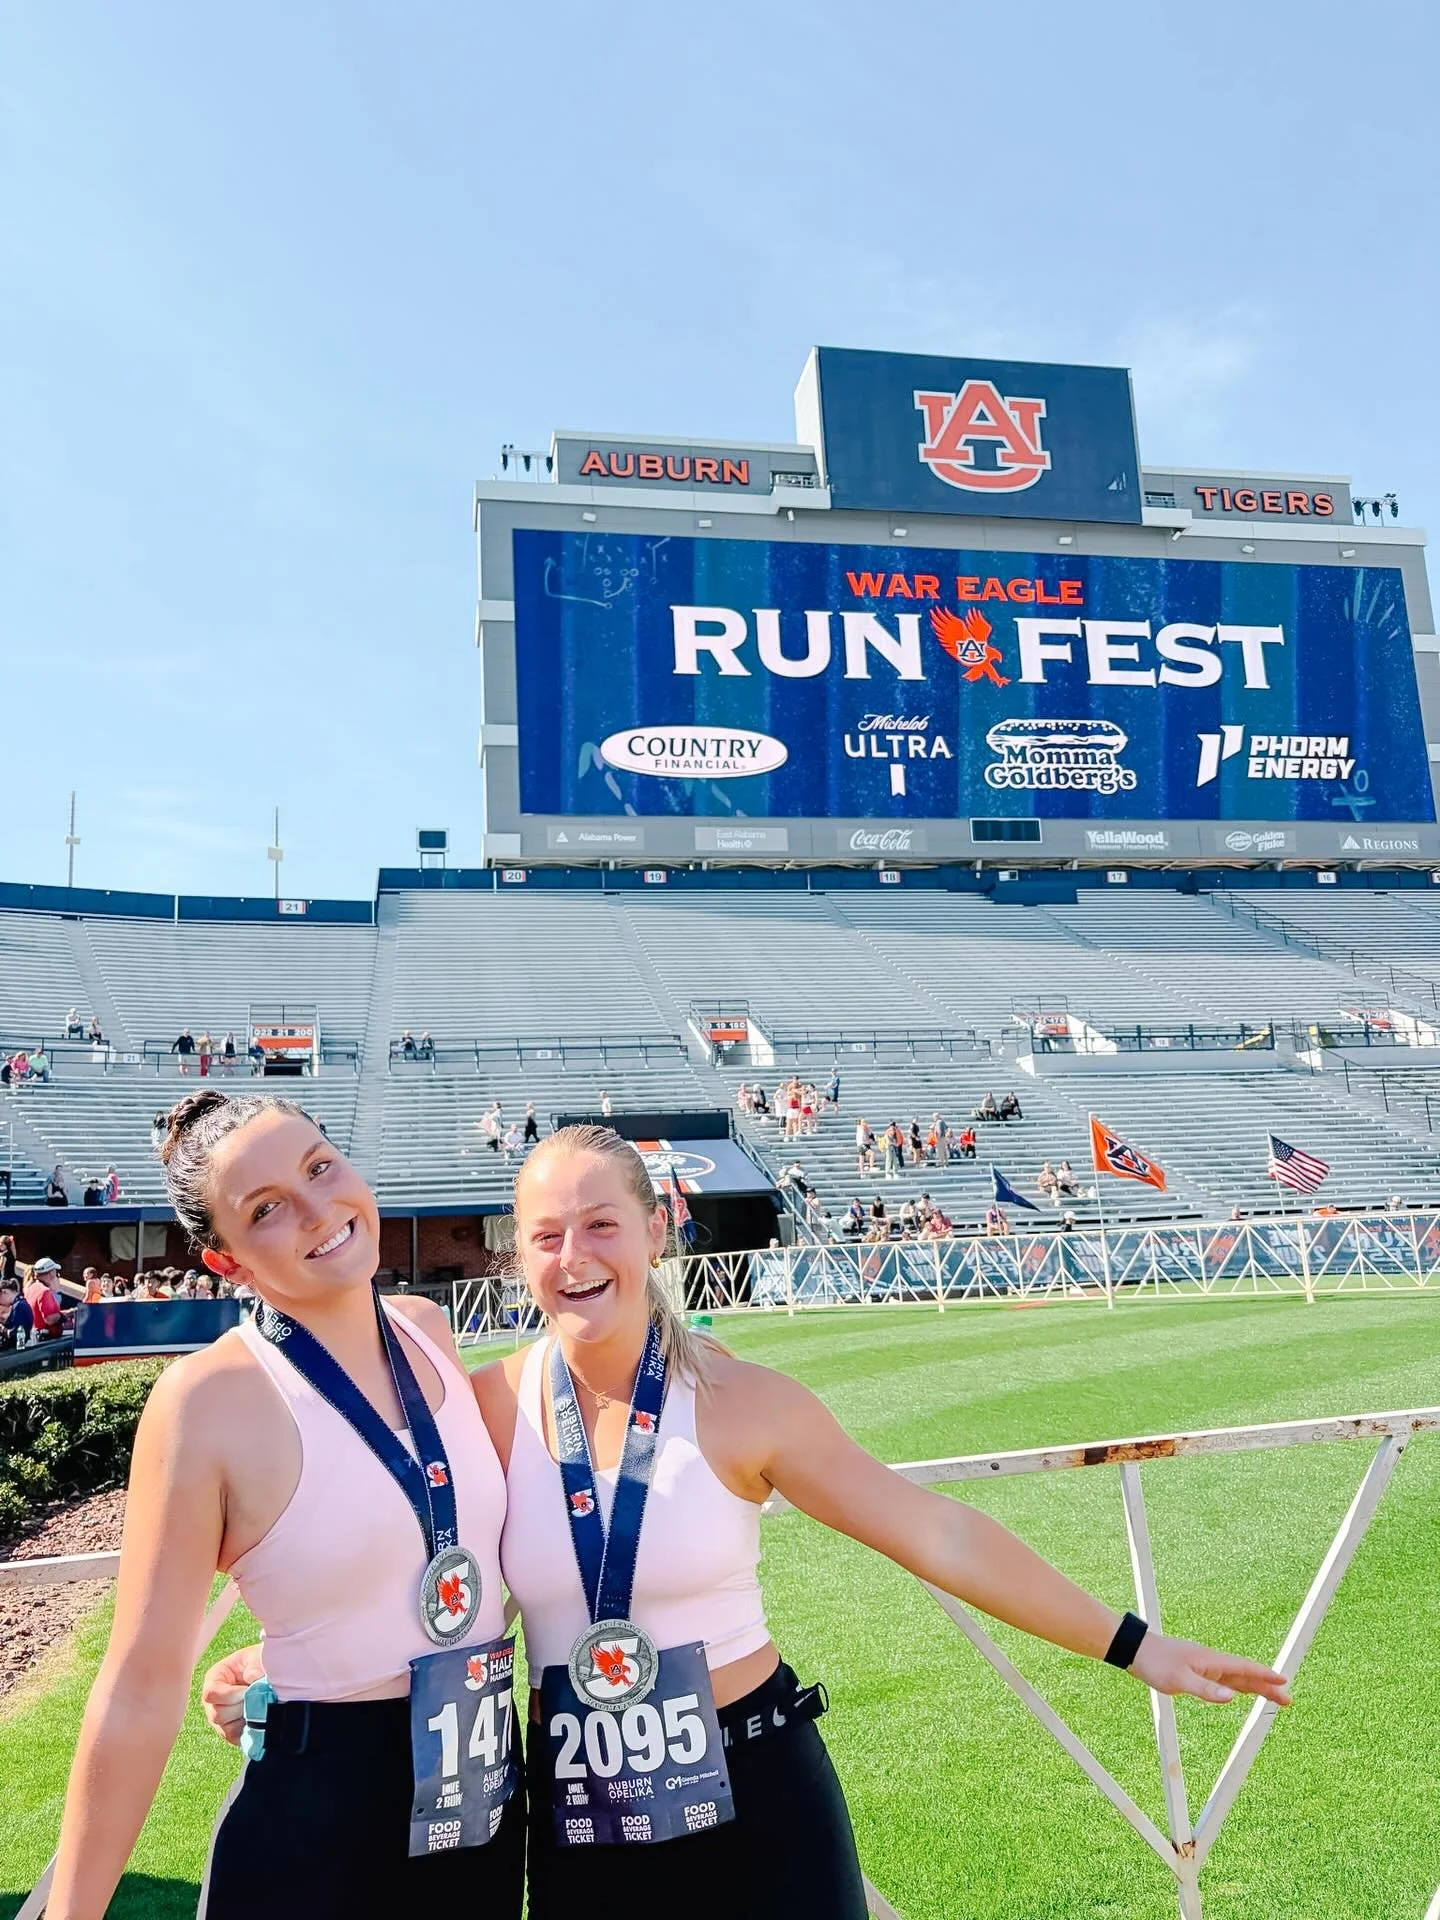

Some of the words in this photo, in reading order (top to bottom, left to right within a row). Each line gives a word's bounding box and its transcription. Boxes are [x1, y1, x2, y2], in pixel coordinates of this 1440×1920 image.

[580, 451, 750, 485] AUBURN
[1196, 486, 1335, 516] TIGERS
[846, 572, 939, 600] WAR
[956, 576, 1084, 604] EAGLE
[670, 604, 927, 681] RUN
[1013, 616, 1285, 689] FEST
[858, 713, 930, 732] Michelob
[627, 736, 762, 758] COUNTRY
[844, 734, 951, 759] ULTRA
[1250, 735, 1349, 758] PHORM
[1004, 746, 1113, 766] Momma
[655, 759, 740, 770] FINANCIAL
[1248, 758, 1356, 780] ENERGY
[988, 766, 1133, 792] Goldberg's
[507, 872, 521, 881] 20
[649, 872, 662, 881] 19
[1112, 873, 1122, 881] 17
[285, 902, 299, 911] 21
[559, 1401, 575, 1457] OPELIKA
[563, 1398, 584, 1453] AUBURN
[428, 1687, 512, 1778] 147
[550, 1693, 707, 1780] 2095
[608, 1776, 652, 1791] AUBURN
[566, 1795, 572, 1805] 2
[609, 1786, 654, 1799] OPELIKA
[436, 1797, 443, 1809] 2
[684, 1801, 716, 1817] FOOD
[428, 1820, 461, 1834] FOOD
[566, 1818, 592, 1829] FOOD
[621, 1815, 650, 1826] FOOD
[687, 1816, 718, 1831] TICKET
[428, 1831, 460, 1842] BEVERAGE
[568, 1834, 595, 1844] TICKET
[624, 1831, 652, 1840] TICKET
[428, 1837, 460, 1851] TICKET
